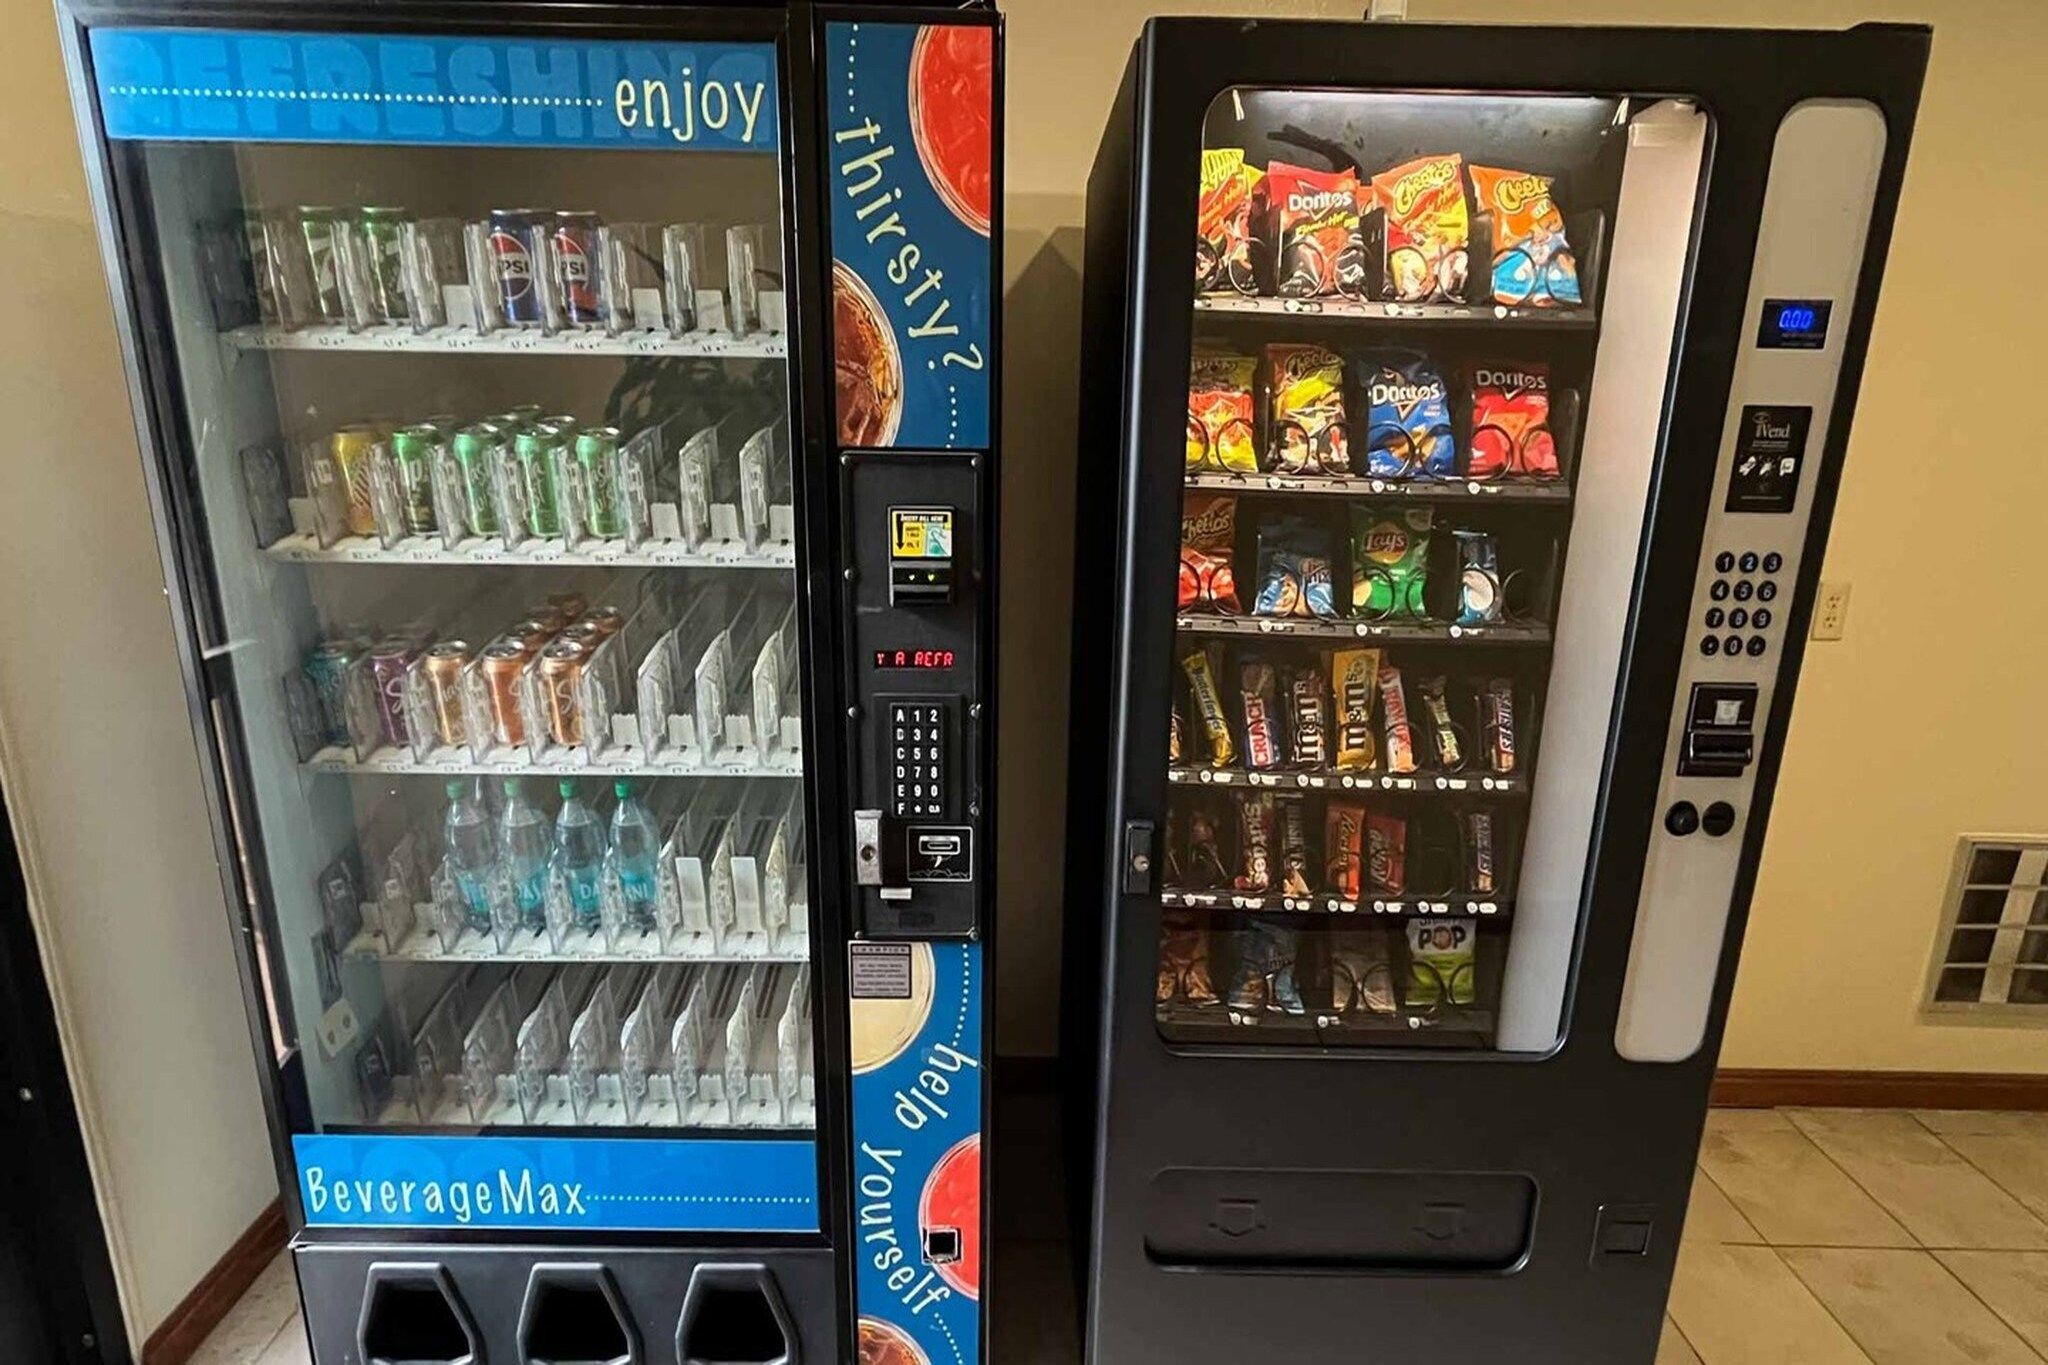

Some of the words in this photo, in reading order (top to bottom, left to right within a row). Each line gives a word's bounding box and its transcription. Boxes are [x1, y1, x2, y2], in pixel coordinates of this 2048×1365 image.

[614, 67, 764, 142] enjoy
[1288, 190, 1353, 212] Doritos
[835, 116, 984, 371] thirsty?
[1476, 369, 1547, 390] Doritos
[1372, 383, 1441, 406] Doritos
[895, 652, 905, 666] A
[896, 709, 905, 722] A
[913, 709, 921, 722] 1
[930, 709, 938, 722] 2
[913, 728, 921, 741] 3
[930, 728, 938, 741] 4
[1246, 693, 1269, 765] CRUNCH
[896, 747, 905, 760] C
[913, 747, 921, 760] 5
[930, 747, 938, 760] 6
[896, 766, 905, 779] D
[913, 766, 921, 779] 7
[930, 766, 938, 779] 8
[896, 784, 905, 797] E
[913, 784, 921, 797] 9
[930, 784, 938, 797] 0
[897, 803, 905, 815] F
[894, 1042, 979, 1130] help
[305, 1165, 587, 1223] BeverageMax
[860, 1141, 951, 1315] yourself
